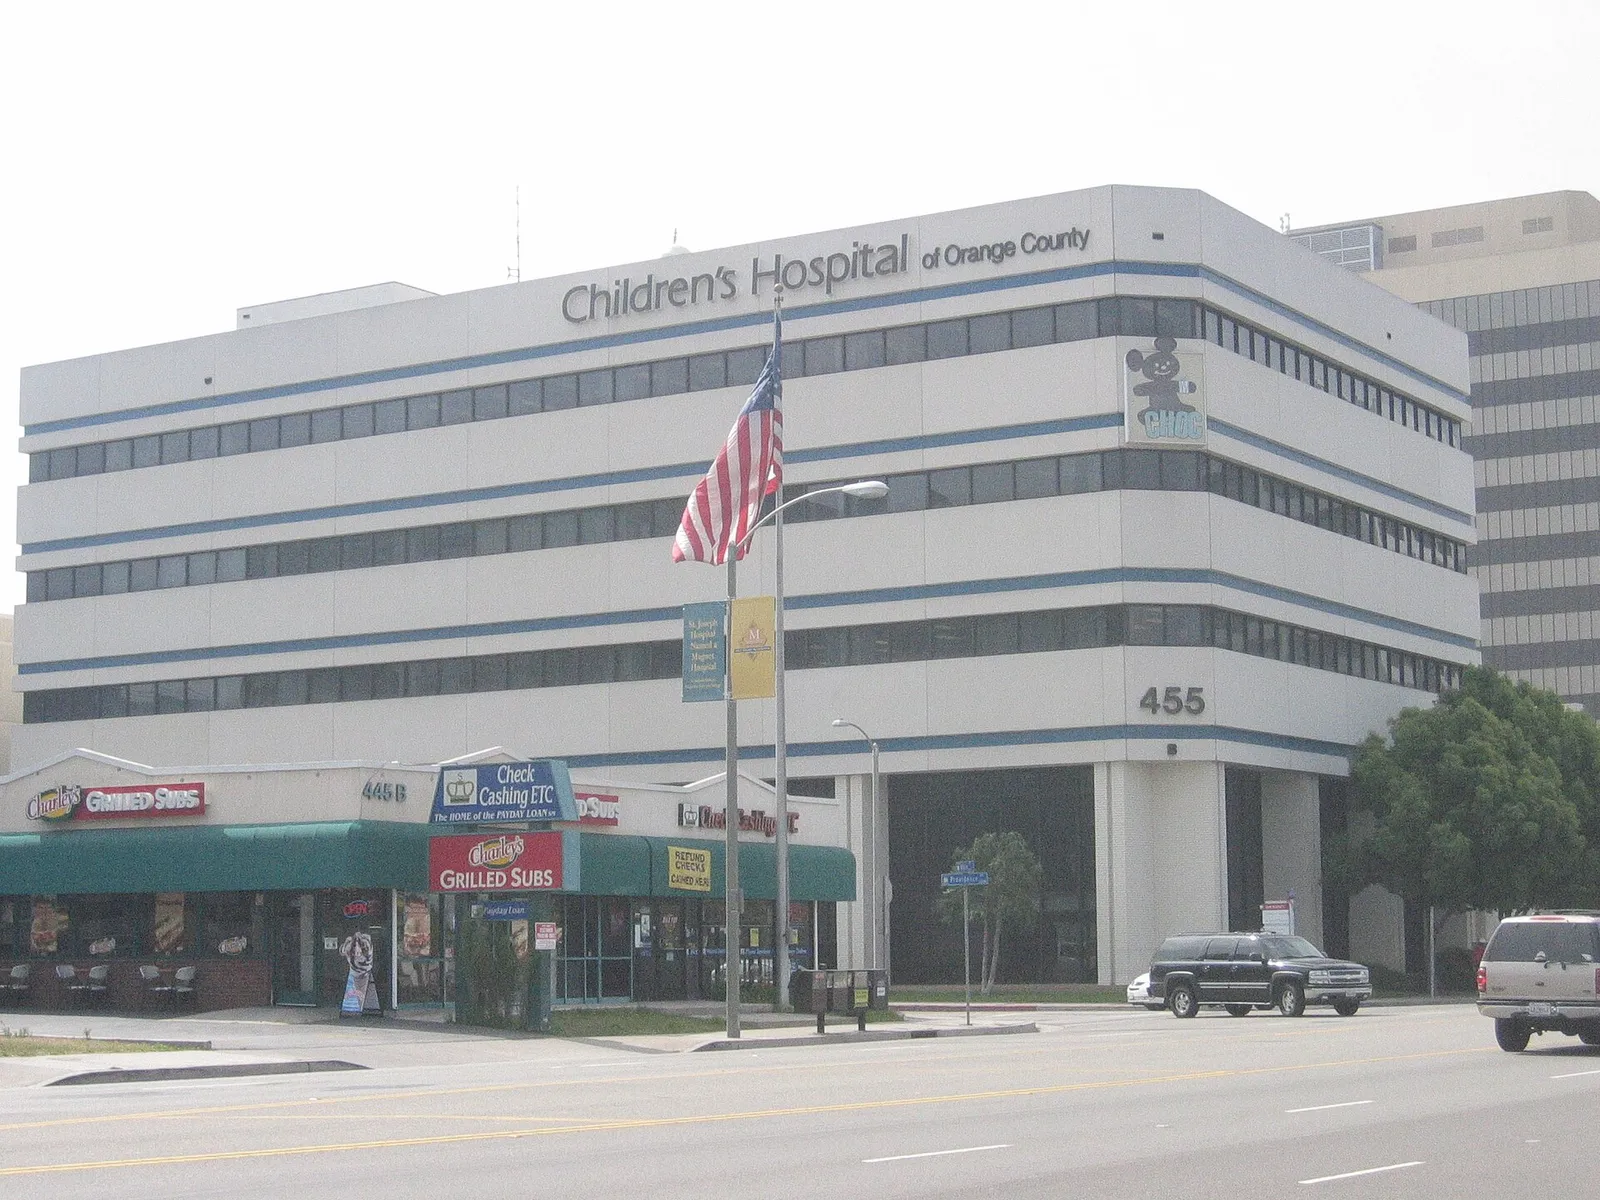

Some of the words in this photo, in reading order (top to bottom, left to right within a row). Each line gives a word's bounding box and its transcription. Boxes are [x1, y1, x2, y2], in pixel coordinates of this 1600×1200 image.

[922, 247, 941, 270] of
[944, 240, 1017, 265] Orange
[1020, 226, 1091, 255] County
[562, 266, 737, 324] Children's
[751, 233, 908, 295] Hospital
[1144, 409, 1203, 440] CHOC
[749, 629, 760, 640] M
[1140, 686, 1205, 715] 455
[497, 764, 535, 784] Check
[362, 780, 392, 801] 445
[396, 784, 407, 802] B
[479, 787, 529, 809] Cashing
[531, 785, 554, 804] ETC
[26, 785, 82, 821] Charley's
[434, 813, 448, 822] The
[449, 812, 472, 821] HOME
[473, 811, 482, 820] of
[482, 811, 495, 820] the
[496, 809, 525, 819] PAYDAY
[526, 808, 547, 818] LOAN
[468, 835, 525, 867] Charley's
[674, 851, 705, 863] REFUND
[440, 869, 507, 890] GRILLED
[510, 867, 553, 888] SUBS
[675, 861, 706, 873] CHECKS
